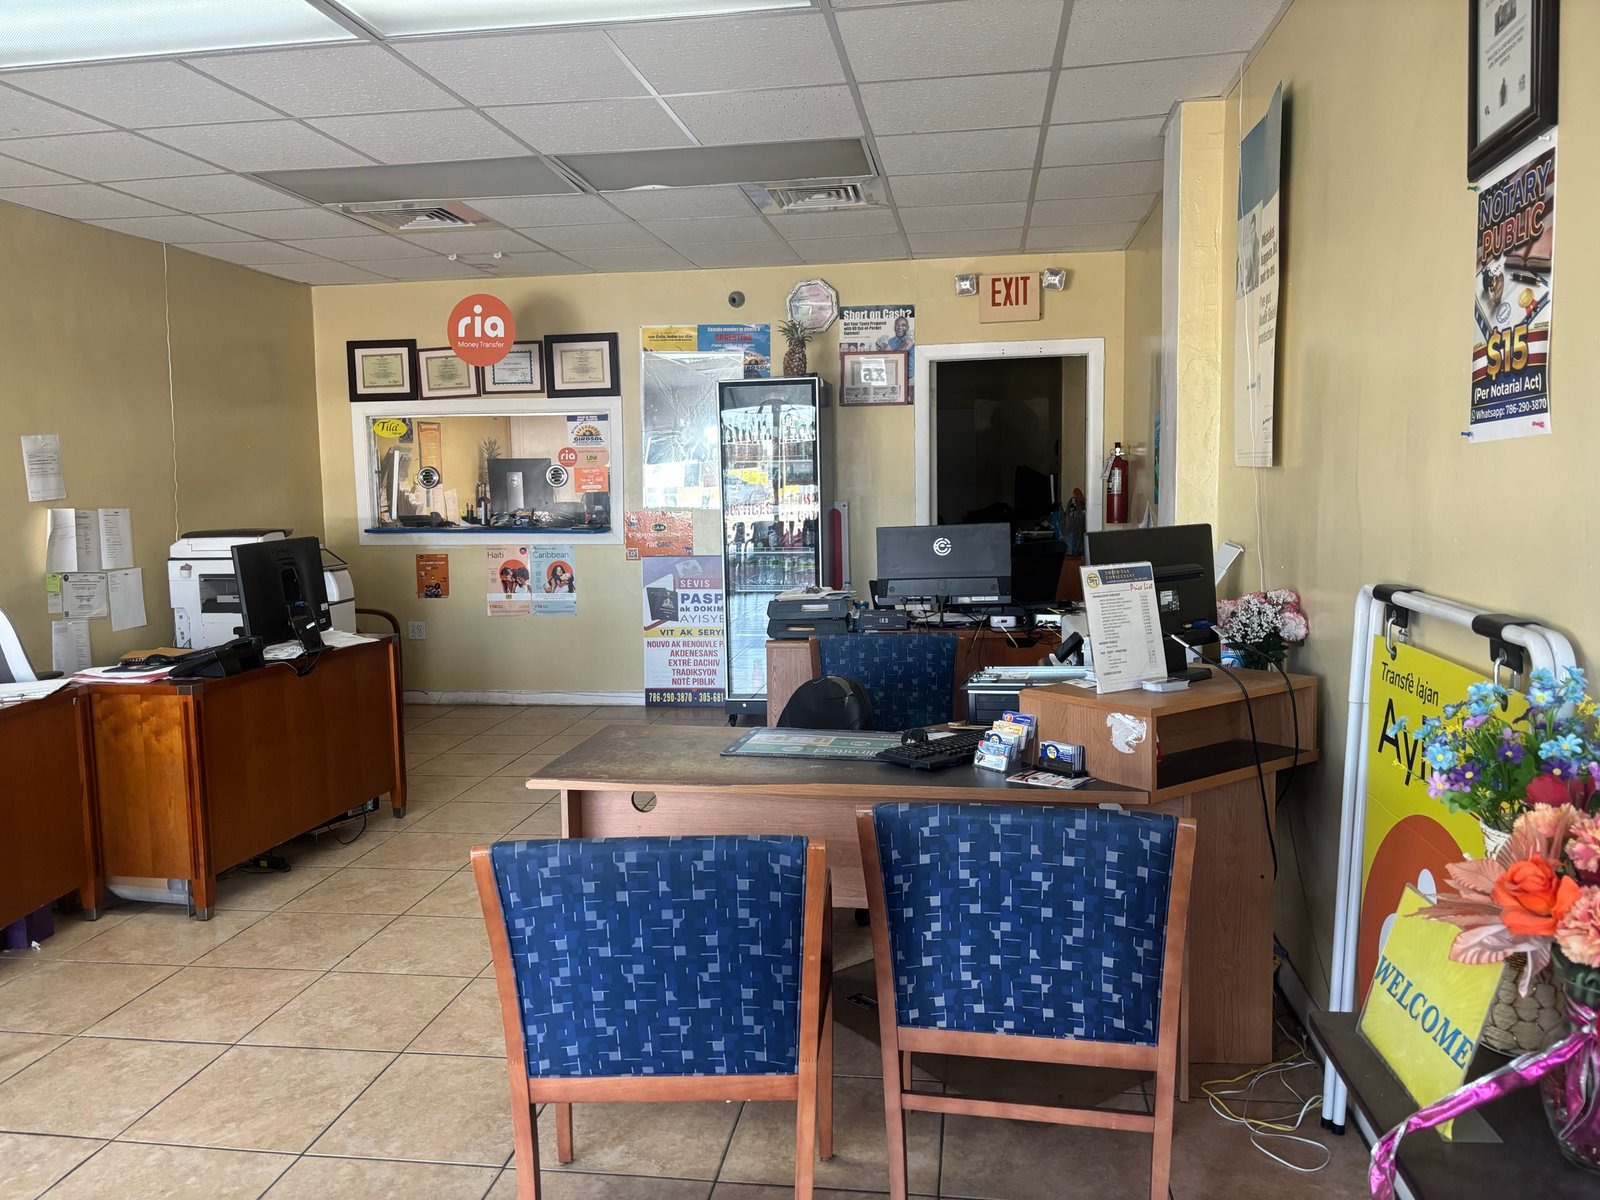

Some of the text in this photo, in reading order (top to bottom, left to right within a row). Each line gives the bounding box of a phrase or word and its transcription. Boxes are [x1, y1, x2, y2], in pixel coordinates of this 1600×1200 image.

[1480, 160, 1551, 230] NOTARY
[1482, 202, 1545, 262] PUBLIC
[991, 276, 1030, 307] EXIT
[458, 304, 505, 338] ria
[843, 308, 912, 321] Short on Cash?
[458, 341, 479, 349] Money
[1487, 324, 1528, 380] $15
[1474, 373, 1542, 404] (Per Notarial Act)
[1505, 398, 1547, 414] 786-290-3870
[560, 450, 576, 460] ria
[487, 551, 504, 559] Haiti
[533, 551, 569, 559] Caribbean
[647, 640, 670, 648] NOUVO
[671, 640, 681, 648] AK
[682, 640, 718, 648] RENOUVLE
[693, 659, 720, 667] DACHIV
[672, 668, 717, 676] TRADIKSYON
[1382, 661, 1439, 707] Transfè lajan
[649, 692, 693, 702] 786-290-3870
[1374, 954, 1474, 1070] WELCOME
